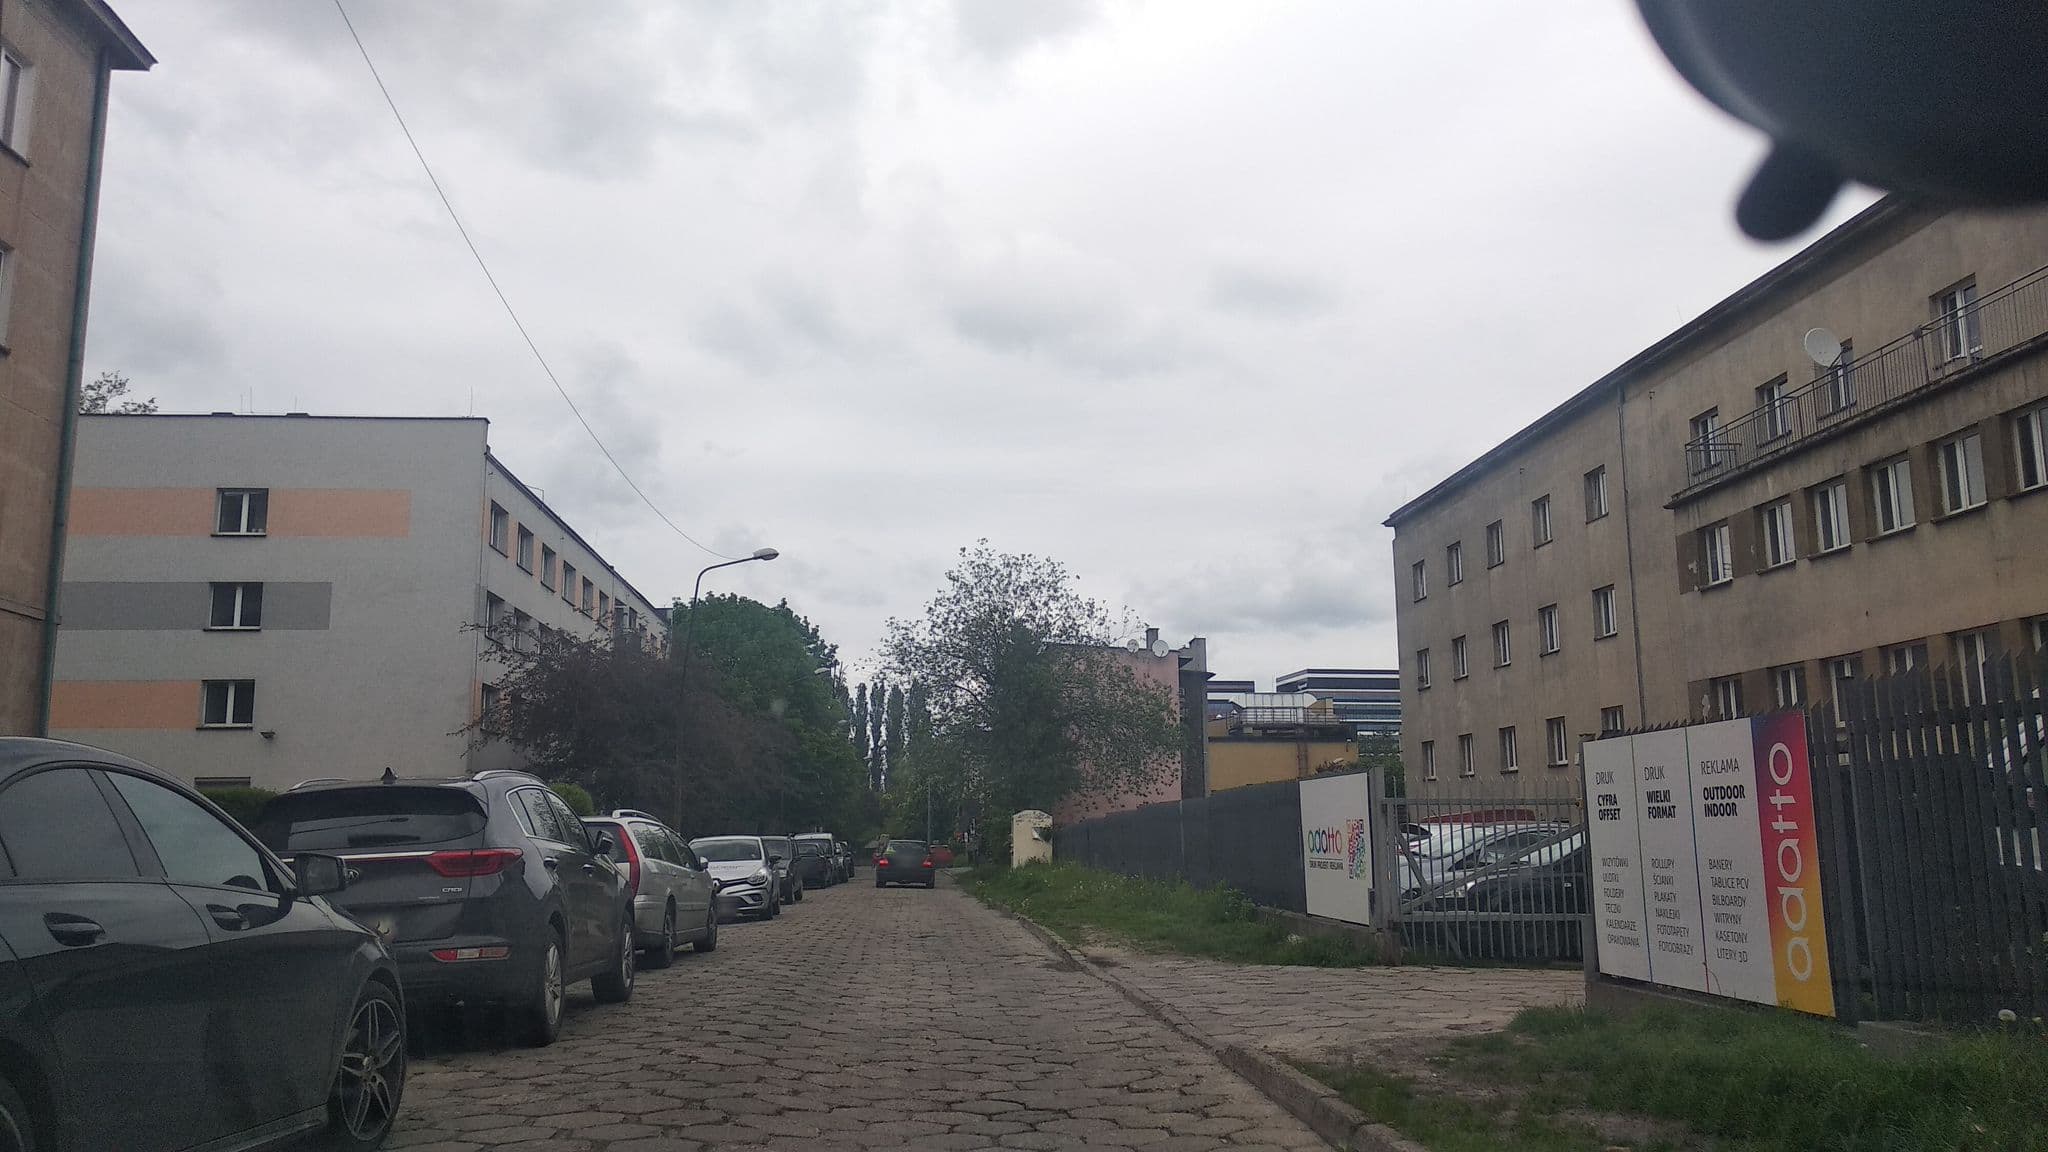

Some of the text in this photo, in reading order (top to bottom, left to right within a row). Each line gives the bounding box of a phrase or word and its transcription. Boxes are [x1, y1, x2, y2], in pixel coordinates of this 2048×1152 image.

[1644, 766, 1665, 780] DRUK
[1701, 758, 1740, 775] REKLAMA
[1596, 771, 1614, 785] DRUK
[1646, 789, 1671, 803] WIELKI
[1703, 784, 1746, 800] OUTDOOR
[1597, 794, 1618, 806] CYFRA
[1599, 808, 1621, 821] OFFSET
[1648, 805, 1676, 819] FORMAT
[1704, 802, 1738, 817] INDOOR
[1708, 858, 1733, 870] BANERY
[1769, 742, 1812, 982] adatto
[1710, 876, 1749, 889] TABLICE PCV
[1654, 891, 1677, 903] PLAKATY
[1712, 894, 1747, 908] BILBOARDY
[1714, 912, 1742, 925] WITRYNY
[1657, 923, 1690, 938] FOTOTAPETY
[1715, 930, 1748, 944] KASETONY
[1658, 940, 1694, 956] FOTOOBRAZY
[1717, 947, 1748, 963] LITERY 3D
